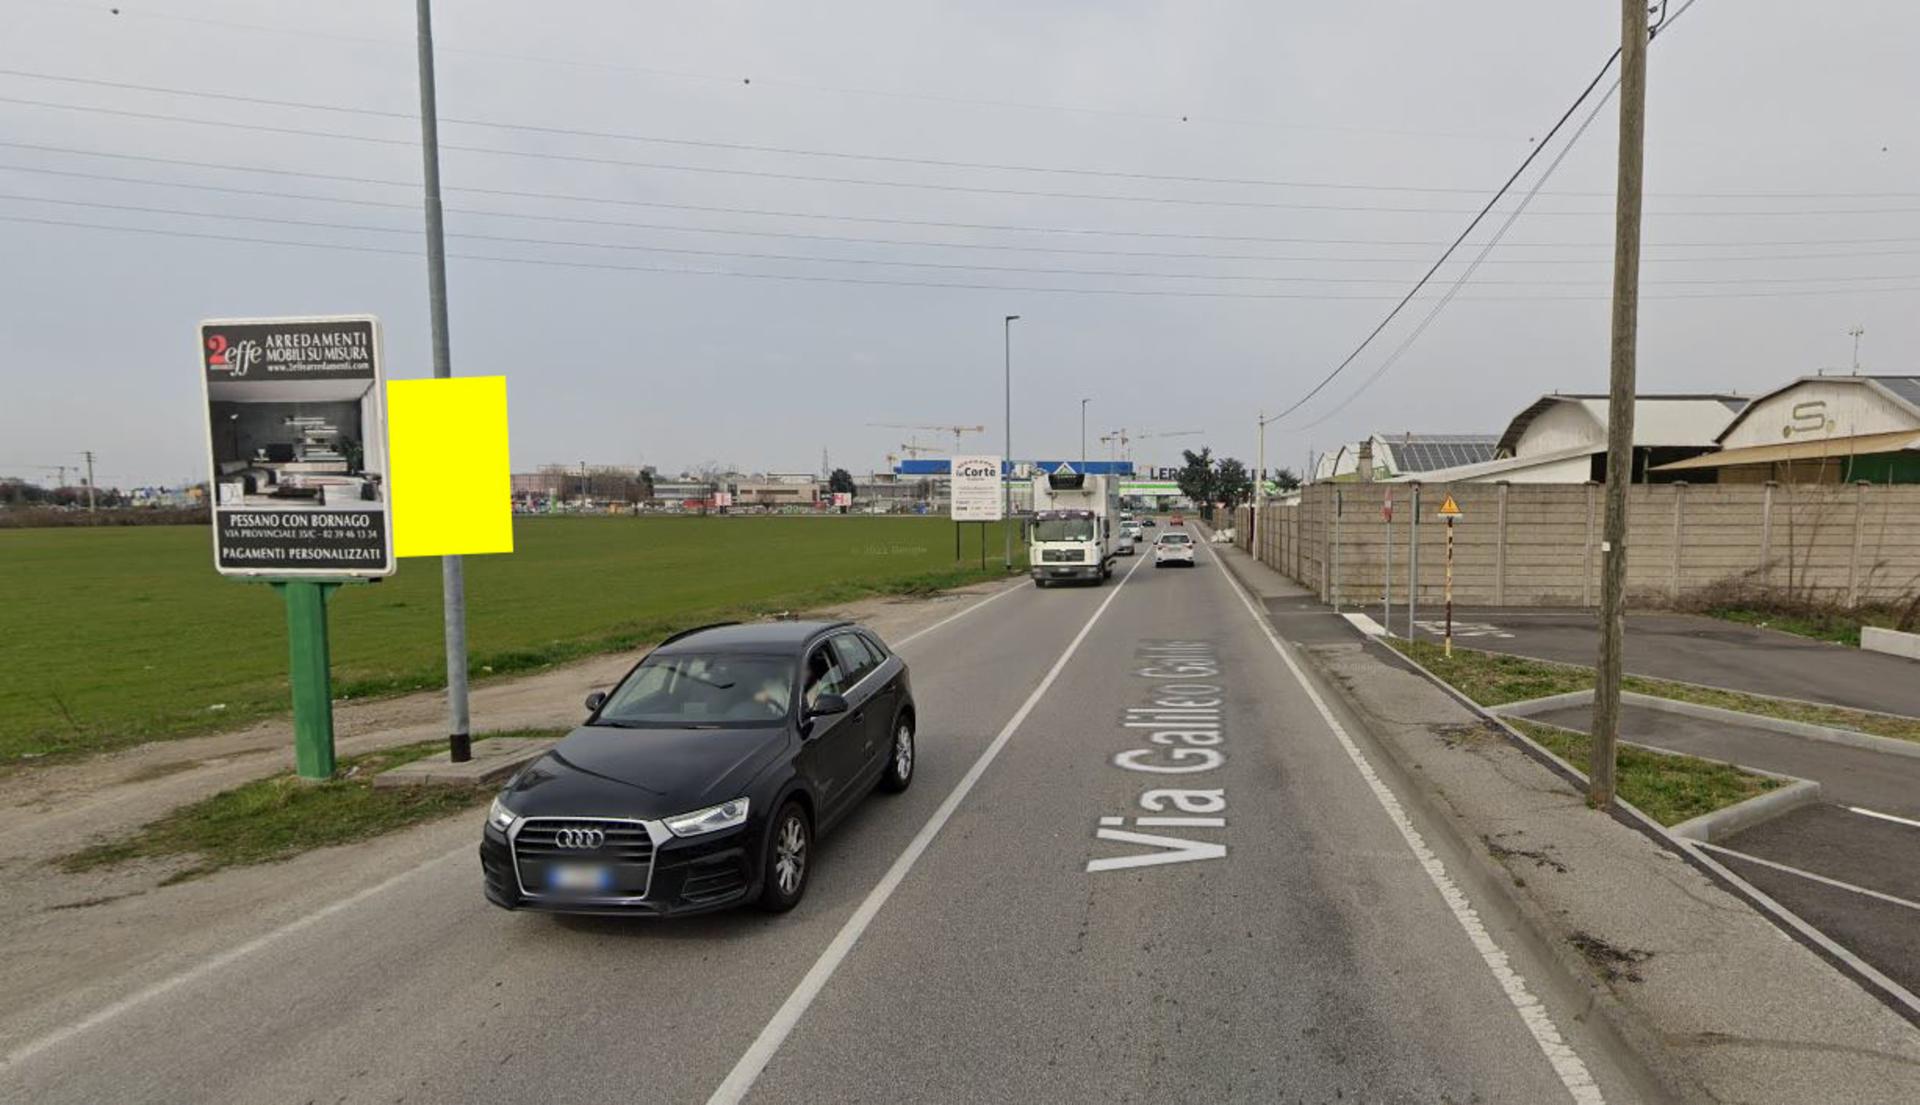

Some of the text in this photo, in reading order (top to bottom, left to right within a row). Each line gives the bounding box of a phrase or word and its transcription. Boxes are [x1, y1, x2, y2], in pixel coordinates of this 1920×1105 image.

[265, 333, 367, 348] ARREDAMENTI
[266, 346, 368, 362] MOBILI SU MISURA
[964, 467, 996, 477] Corte
[230, 514, 370, 527] PESSANO CON BORNAGO
[224, 530, 240, 539] VIA
[241, 529, 296, 539] PROVINCIALE
[334, 529, 344, 539] 39
[345, 529, 355, 539] 46
[357, 529, 366, 539] 13
[367, 529, 377, 539] 34
[222, 547, 381, 560] PAGAMENTI PERSONALIZZATI
